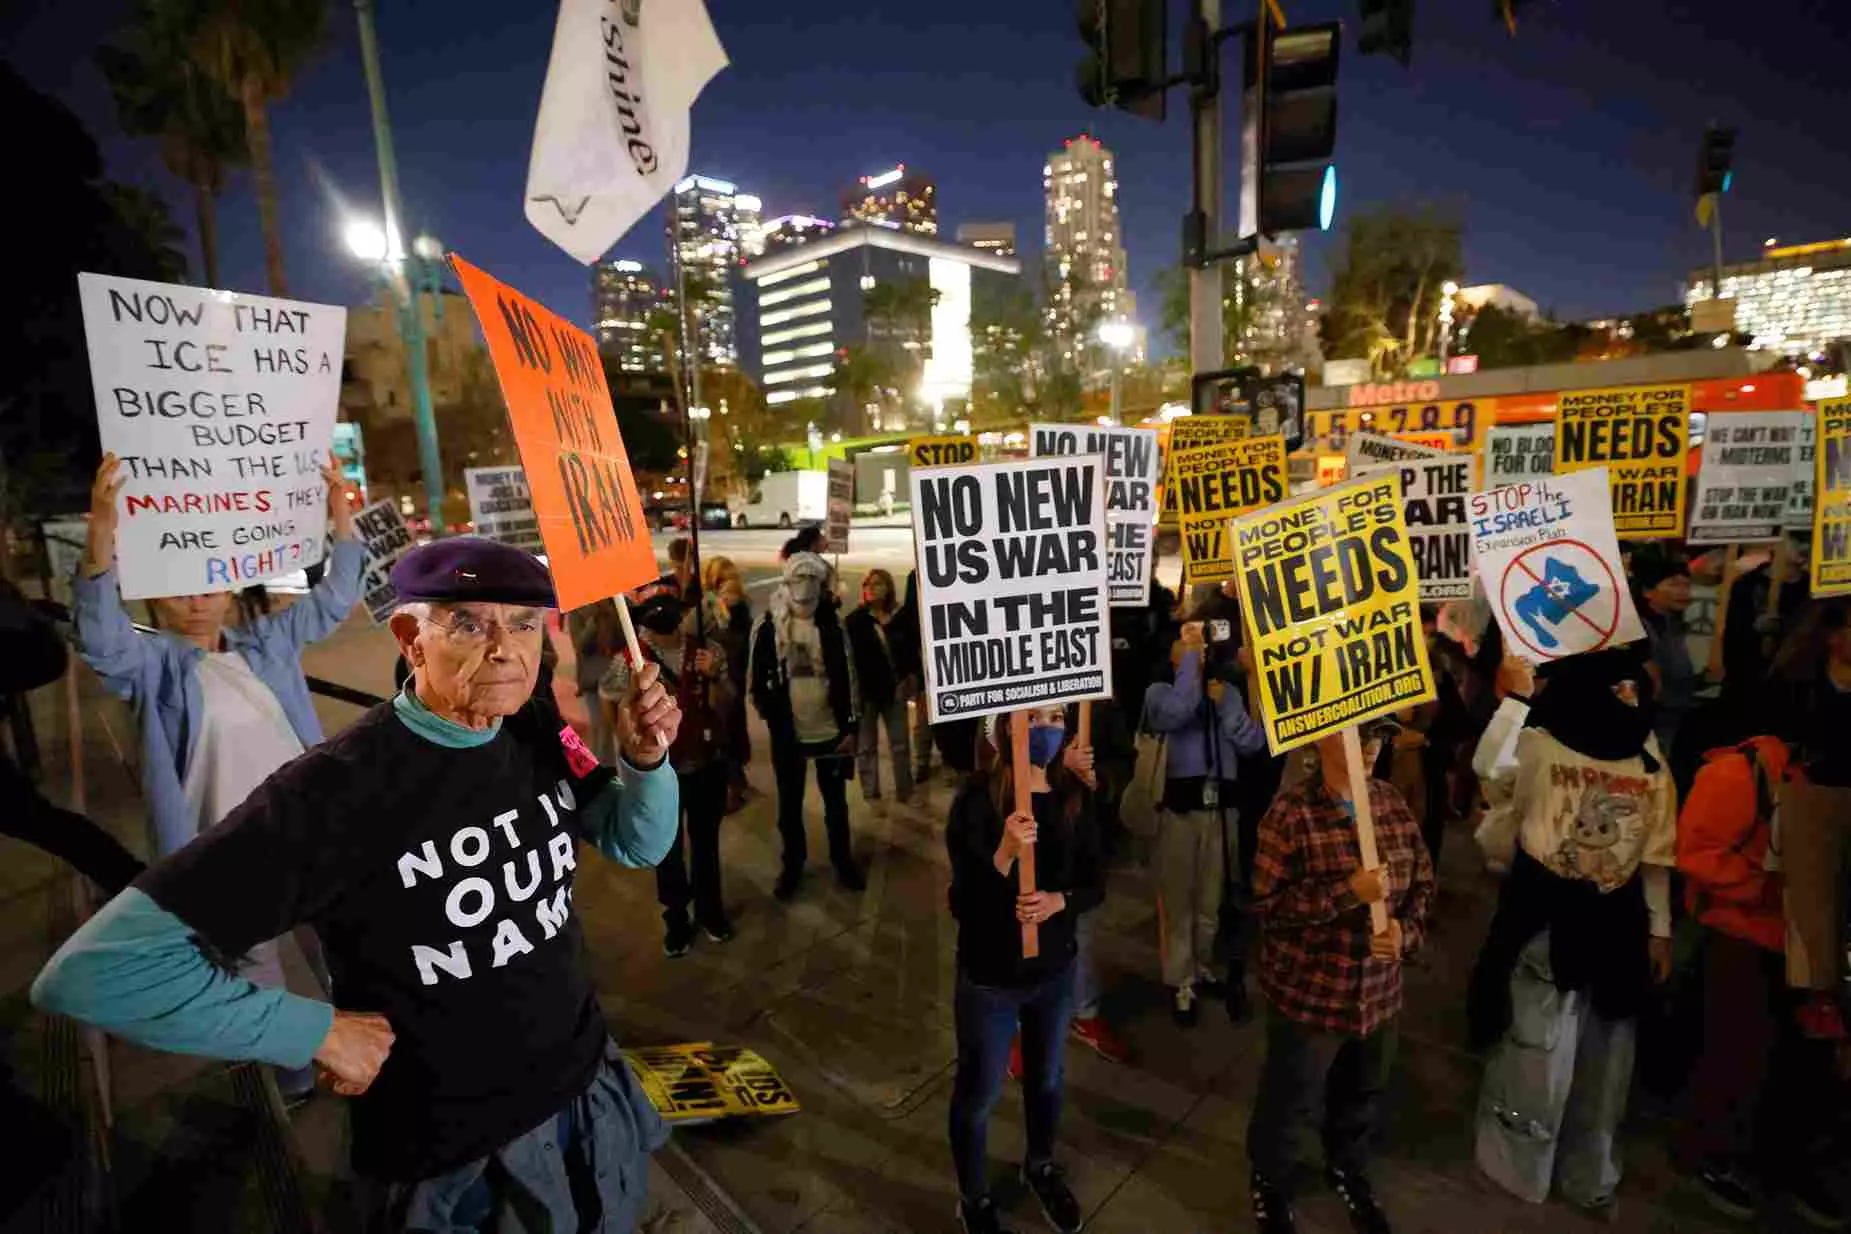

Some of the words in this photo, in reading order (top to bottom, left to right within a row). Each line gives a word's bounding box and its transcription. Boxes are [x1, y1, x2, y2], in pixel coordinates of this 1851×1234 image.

[108, 289, 203, 326] NOW
[232, 304, 311, 333] THAT
[144, 339, 232, 373] ICE
[254, 349, 309, 375] HAS
[318, 351, 331, 373] A
[497, 292, 552, 375] NO
[550, 321, 602, 393] WAR
[112, 387, 266, 418] BIGGER
[1351, 380, 1440, 405] Metro
[1562, 393, 1637, 406] MONEY
[1642, 389, 1685, 401] FOR
[1562, 401, 1684, 418] PEOPLE'S
[191, 421, 309, 446] BUDGET
[1562, 416, 1681, 463] NEEDS
[121, 456, 213, 479] THAN
[228, 455, 286, 479] THE
[915, 442, 974, 466] STOP
[1036, 430, 1077, 456] NO
[1086, 433, 1151, 477] NEW
[1177, 446, 1238, 465] MONEY
[1243, 439, 1279, 454] FOR
[1179, 451, 1280, 475] PEOPLE'S
[1494, 455, 1525, 473] FOR
[1181, 464, 1283, 514] NEEDS
[1424, 464, 1468, 496] THE
[1618, 466, 1679, 480] WAR
[558, 452, 635, 558] IRAN
[920, 475, 983, 541] NO
[995, 465, 1095, 533] NEW
[1107, 481, 1149, 511] AR
[1405, 496, 1467, 527] AR
[1471, 483, 1532, 516] STOP
[1536, 481, 1563, 505] the
[1613, 481, 1678, 513] IRAN
[1240, 505, 1329, 546] MONEY
[1338, 485, 1393, 513] FOR
[1472, 500, 1574, 537] ISRAELI
[160, 530, 218, 550] ARE
[232, 520, 295, 545] GOING
[1107, 523, 1147, 549] HE
[1187, 530, 1222, 561] W/
[1242, 503, 1397, 569] PEOPLE'S
[925, 539, 990, 588] US
[992, 530, 1098, 579] WAR
[1409, 532, 1469, 580] RAN!
[1246, 526, 1408, 636] NEEDS
[930, 600, 988, 640] IN
[993, 587, 1099, 631] THE
[1263, 628, 1328, 666] NOT
[1335, 602, 1411, 639] WAR
[934, 634, 1035, 687] MIDDLE
[1040, 626, 1100, 672] EAST
[1266, 654, 1322, 714] W/
[1336, 622, 1418, 693] IRAN
[960, 692, 987, 708] PARTY
[987, 690, 1004, 703] FOR
[1005, 684, 1048, 702] SOCIALISM
[1049, 682, 1056, 695] &
[1057, 675, 1103, 694] LIBERATION
[1278, 673, 1422, 740] ANSWERCOALITION.ORG
[397, 808, 521, 888] NOT
[445, 832, 577, 928] OUR
[411, 884, 573, 986] NAM
